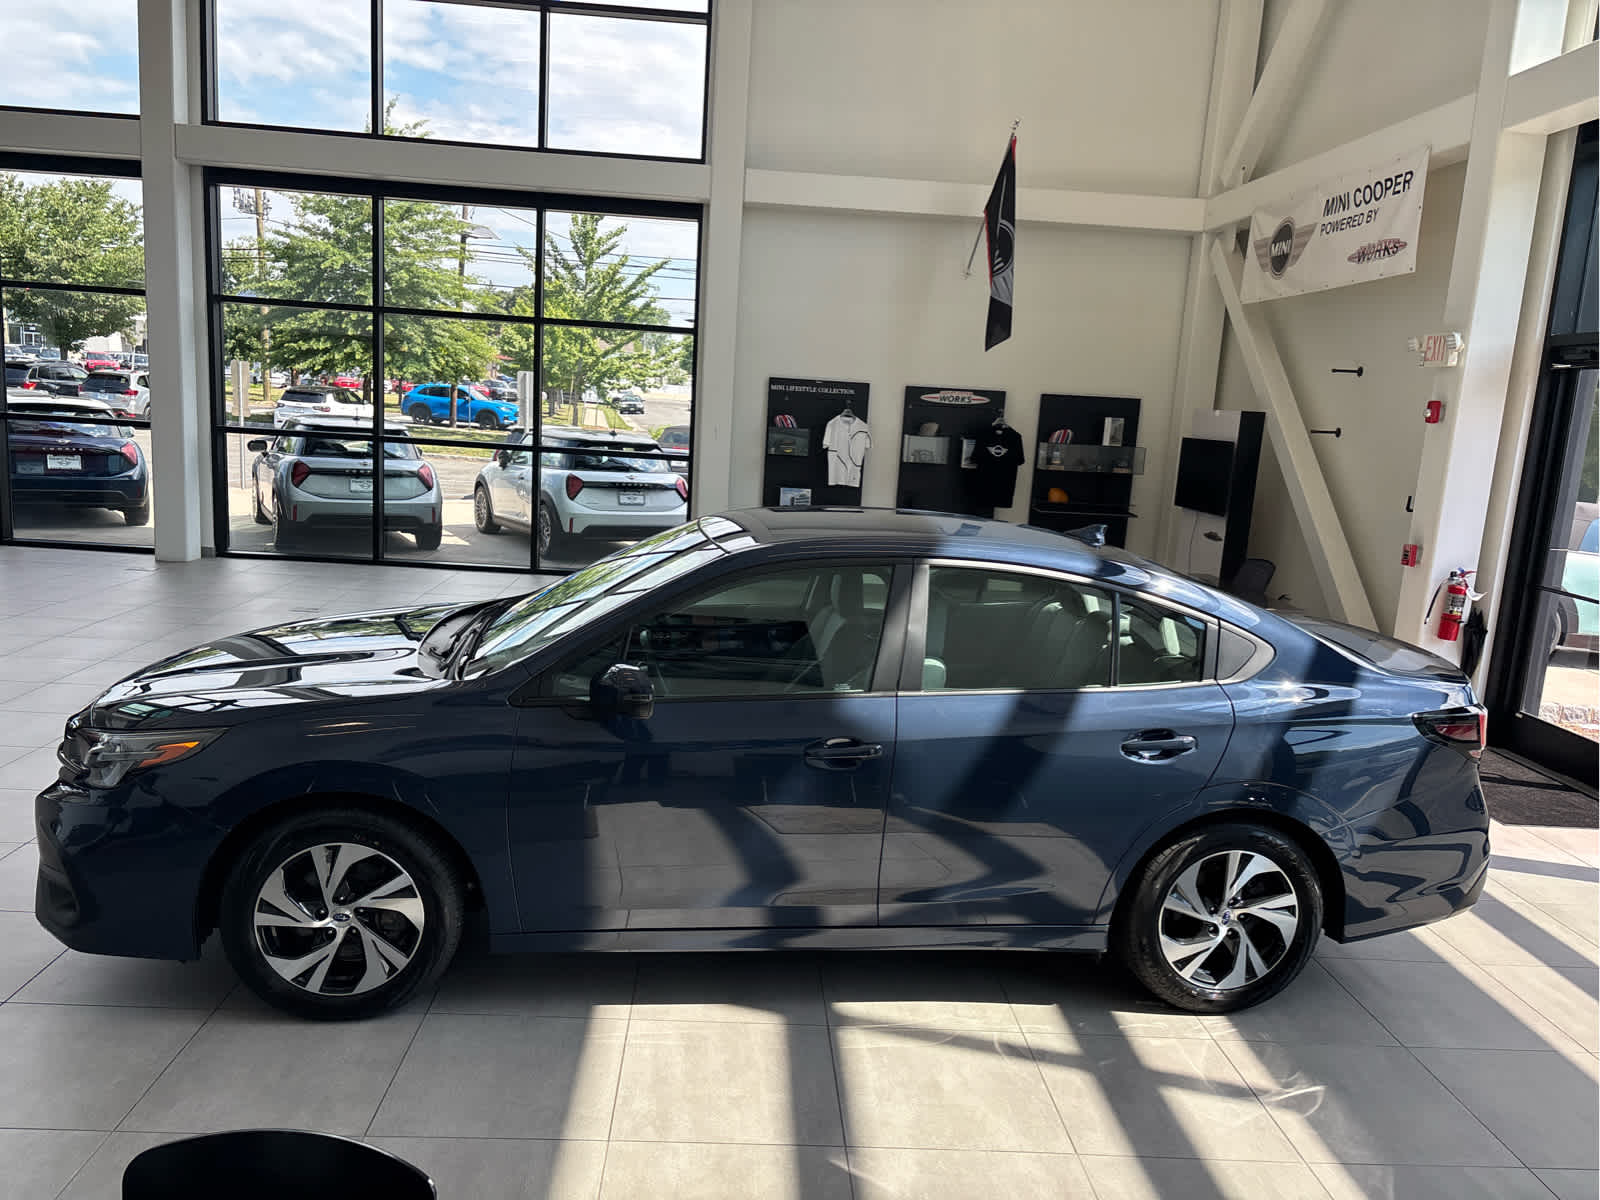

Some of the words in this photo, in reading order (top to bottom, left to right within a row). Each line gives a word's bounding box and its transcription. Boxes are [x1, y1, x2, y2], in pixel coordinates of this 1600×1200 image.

[1322, 192, 1350, 217] MINI
[1353, 170, 1414, 208] COOPER
[1320, 212, 1365, 236] POWERED
[1366, 208, 1379, 223] BY
[1271, 240, 1291, 257] MINI
[818, 387, 856, 395] COLLECTION
[939, 394, 972, 404] WORKS
